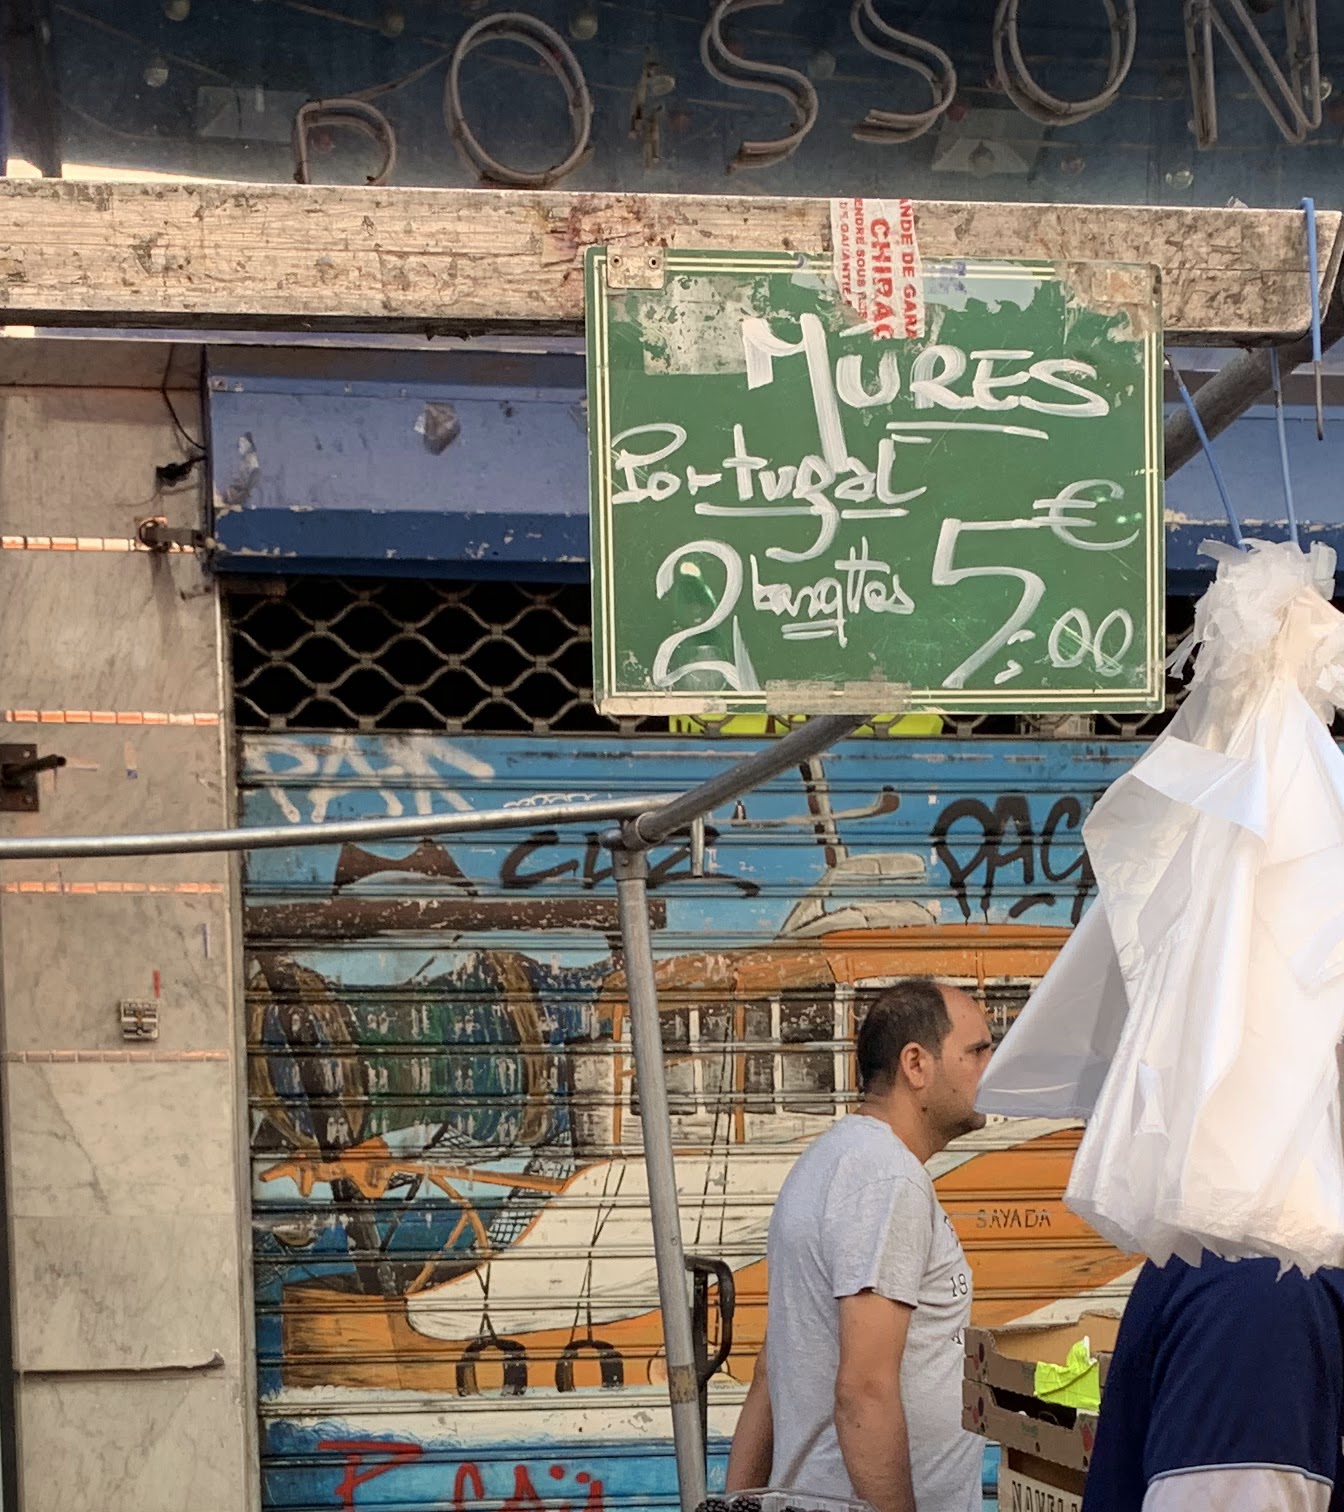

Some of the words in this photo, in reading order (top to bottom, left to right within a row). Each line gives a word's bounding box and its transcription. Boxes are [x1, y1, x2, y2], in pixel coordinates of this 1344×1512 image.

[1032, 479, 1141, 551] €
[652, 540, 759, 692] 2
[975, 1208, 1052, 1229] SAYADA
